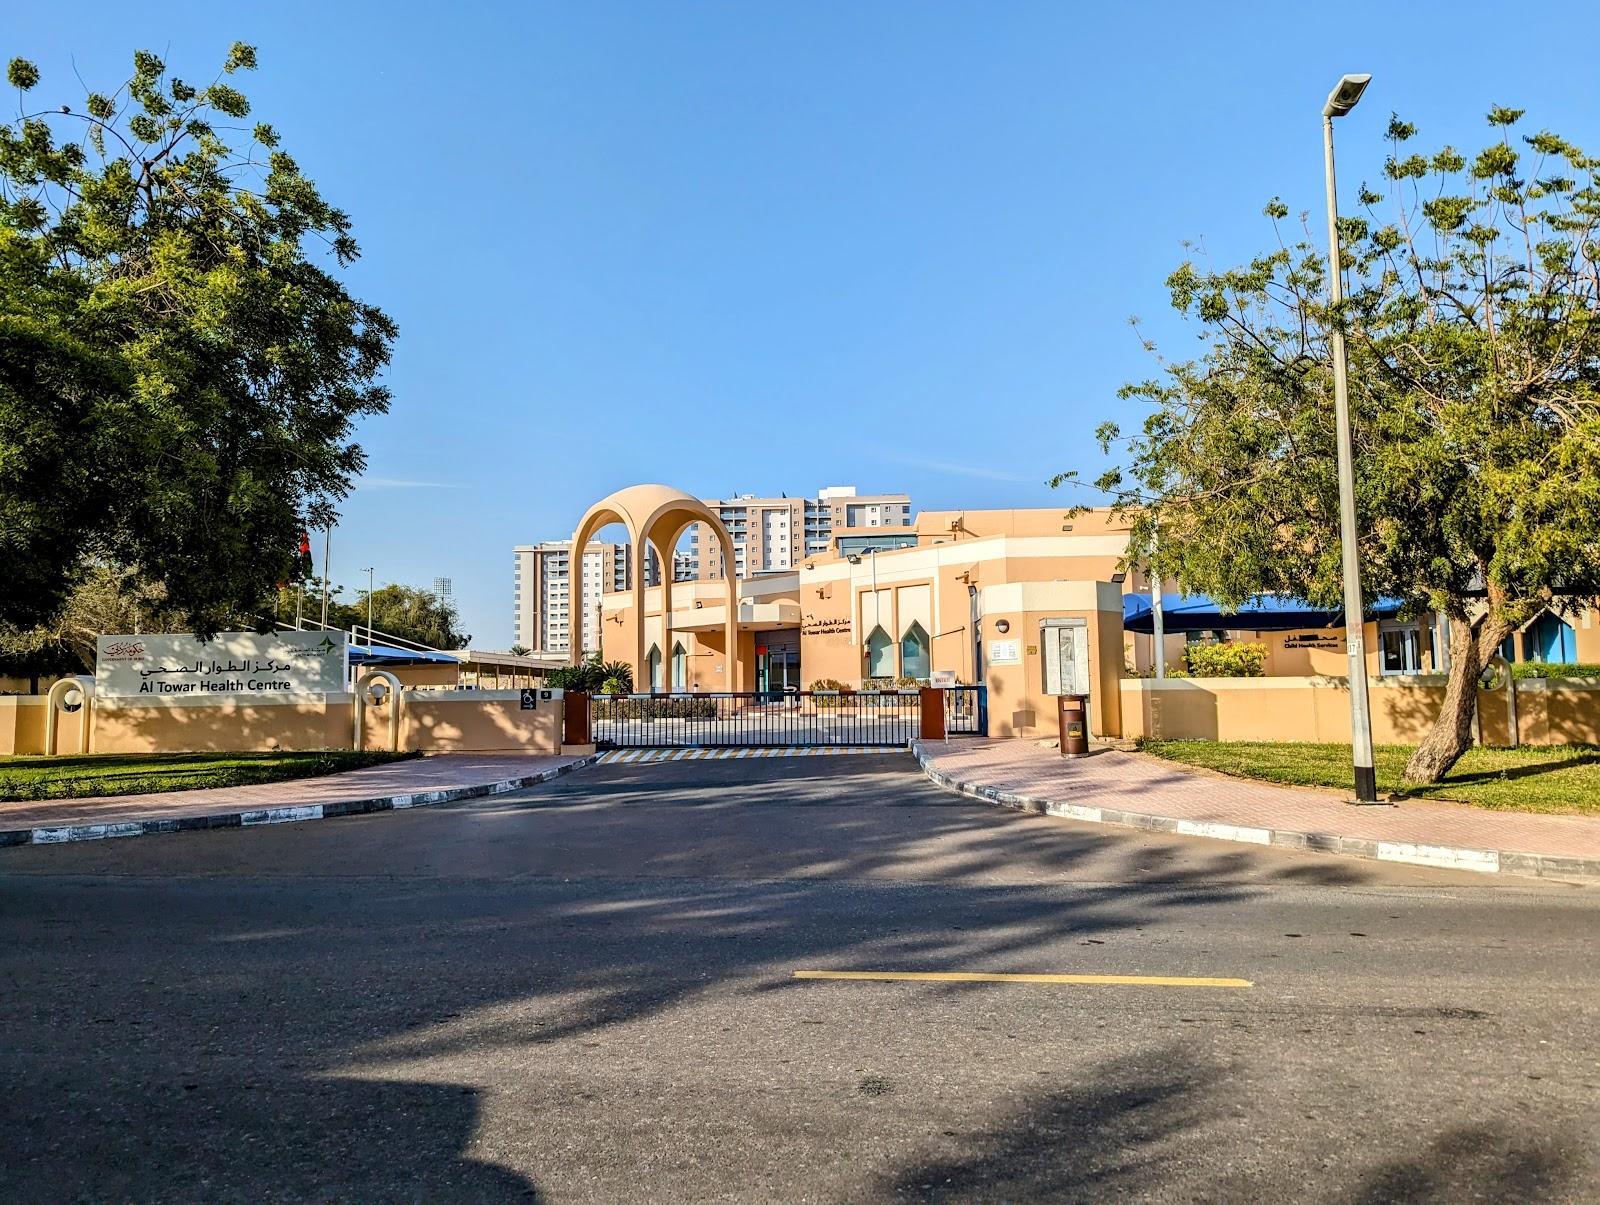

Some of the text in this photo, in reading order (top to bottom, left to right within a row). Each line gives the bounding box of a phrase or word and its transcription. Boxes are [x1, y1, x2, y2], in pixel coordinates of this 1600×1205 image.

[140, 660, 291, 679] مركز الطوار الصحي
[140, 679, 291, 693] Al Towar Health Centre
